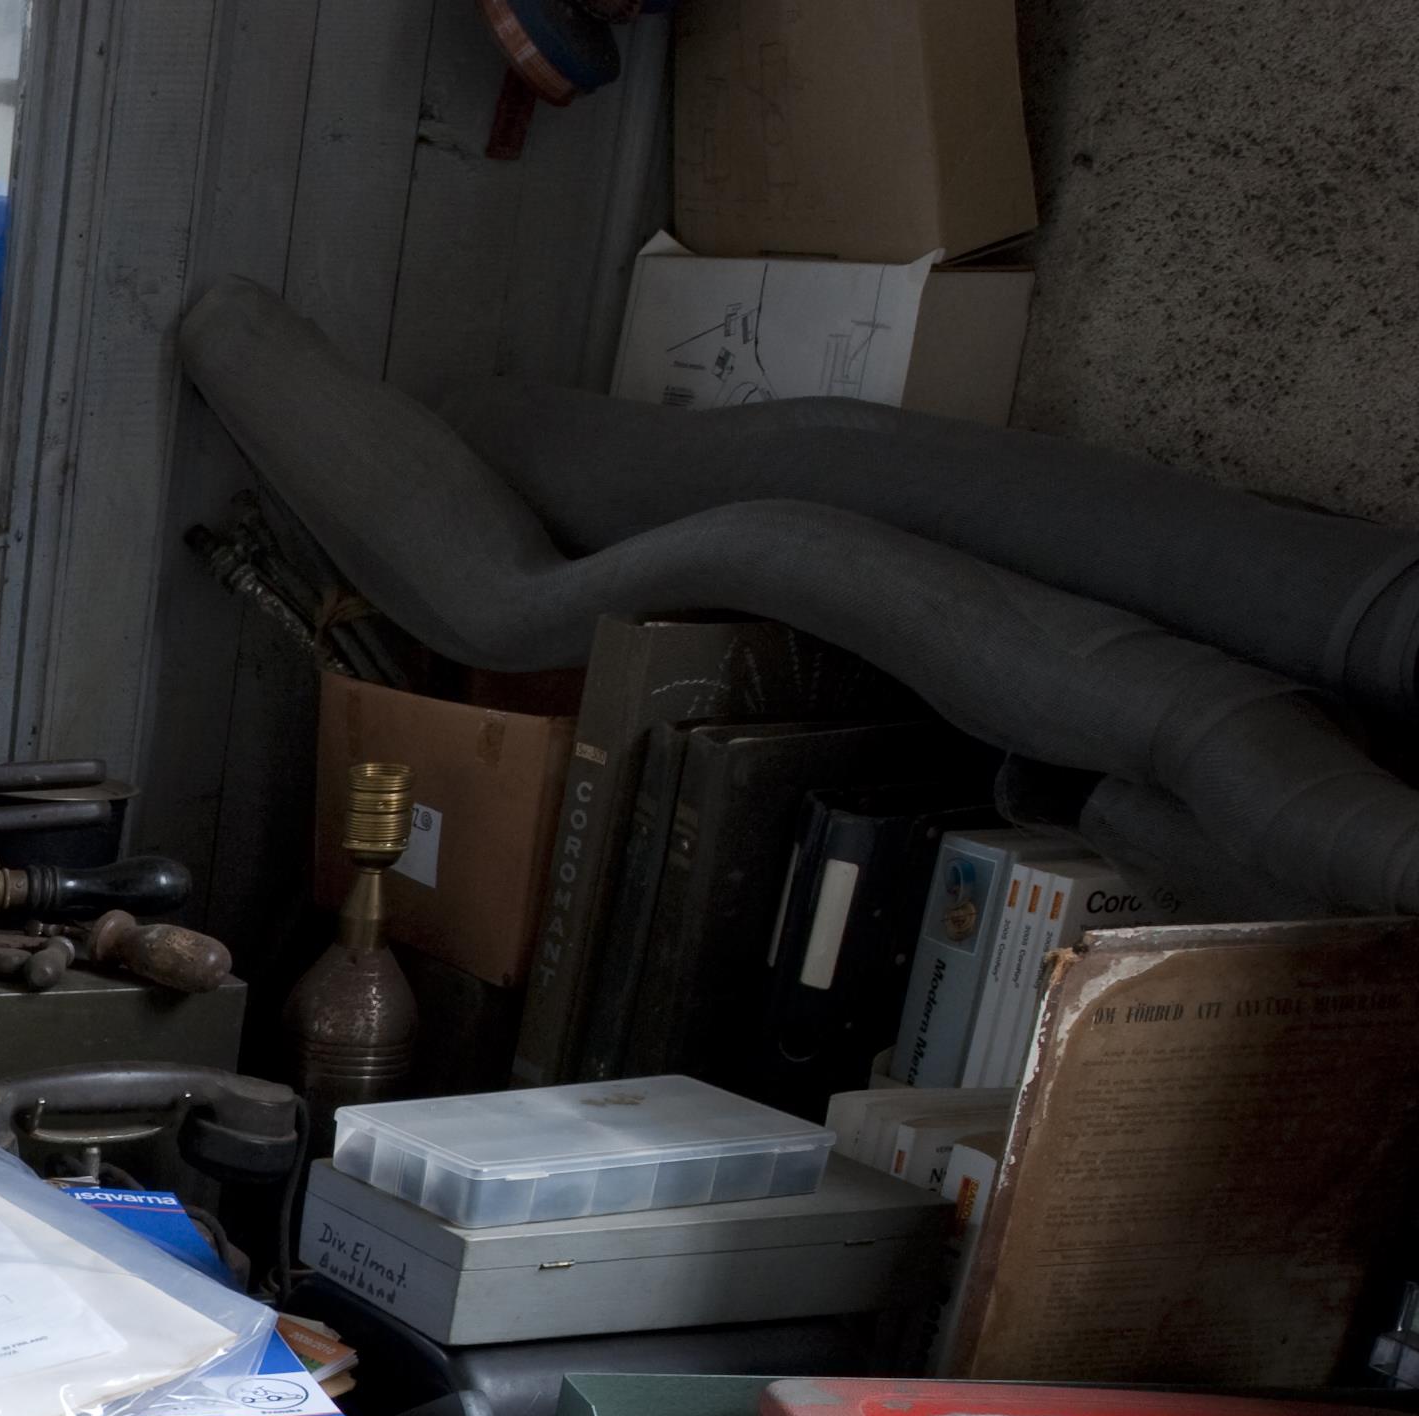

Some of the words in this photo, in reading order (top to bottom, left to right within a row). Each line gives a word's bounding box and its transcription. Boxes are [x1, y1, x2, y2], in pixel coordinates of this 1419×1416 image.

[918, 958, 946, 1034] Modern
[906, 1036, 928, 1087] Meta
[318, 1222, 346, 1254] Div.
[350, 1242, 406, 1288] Elmat.
